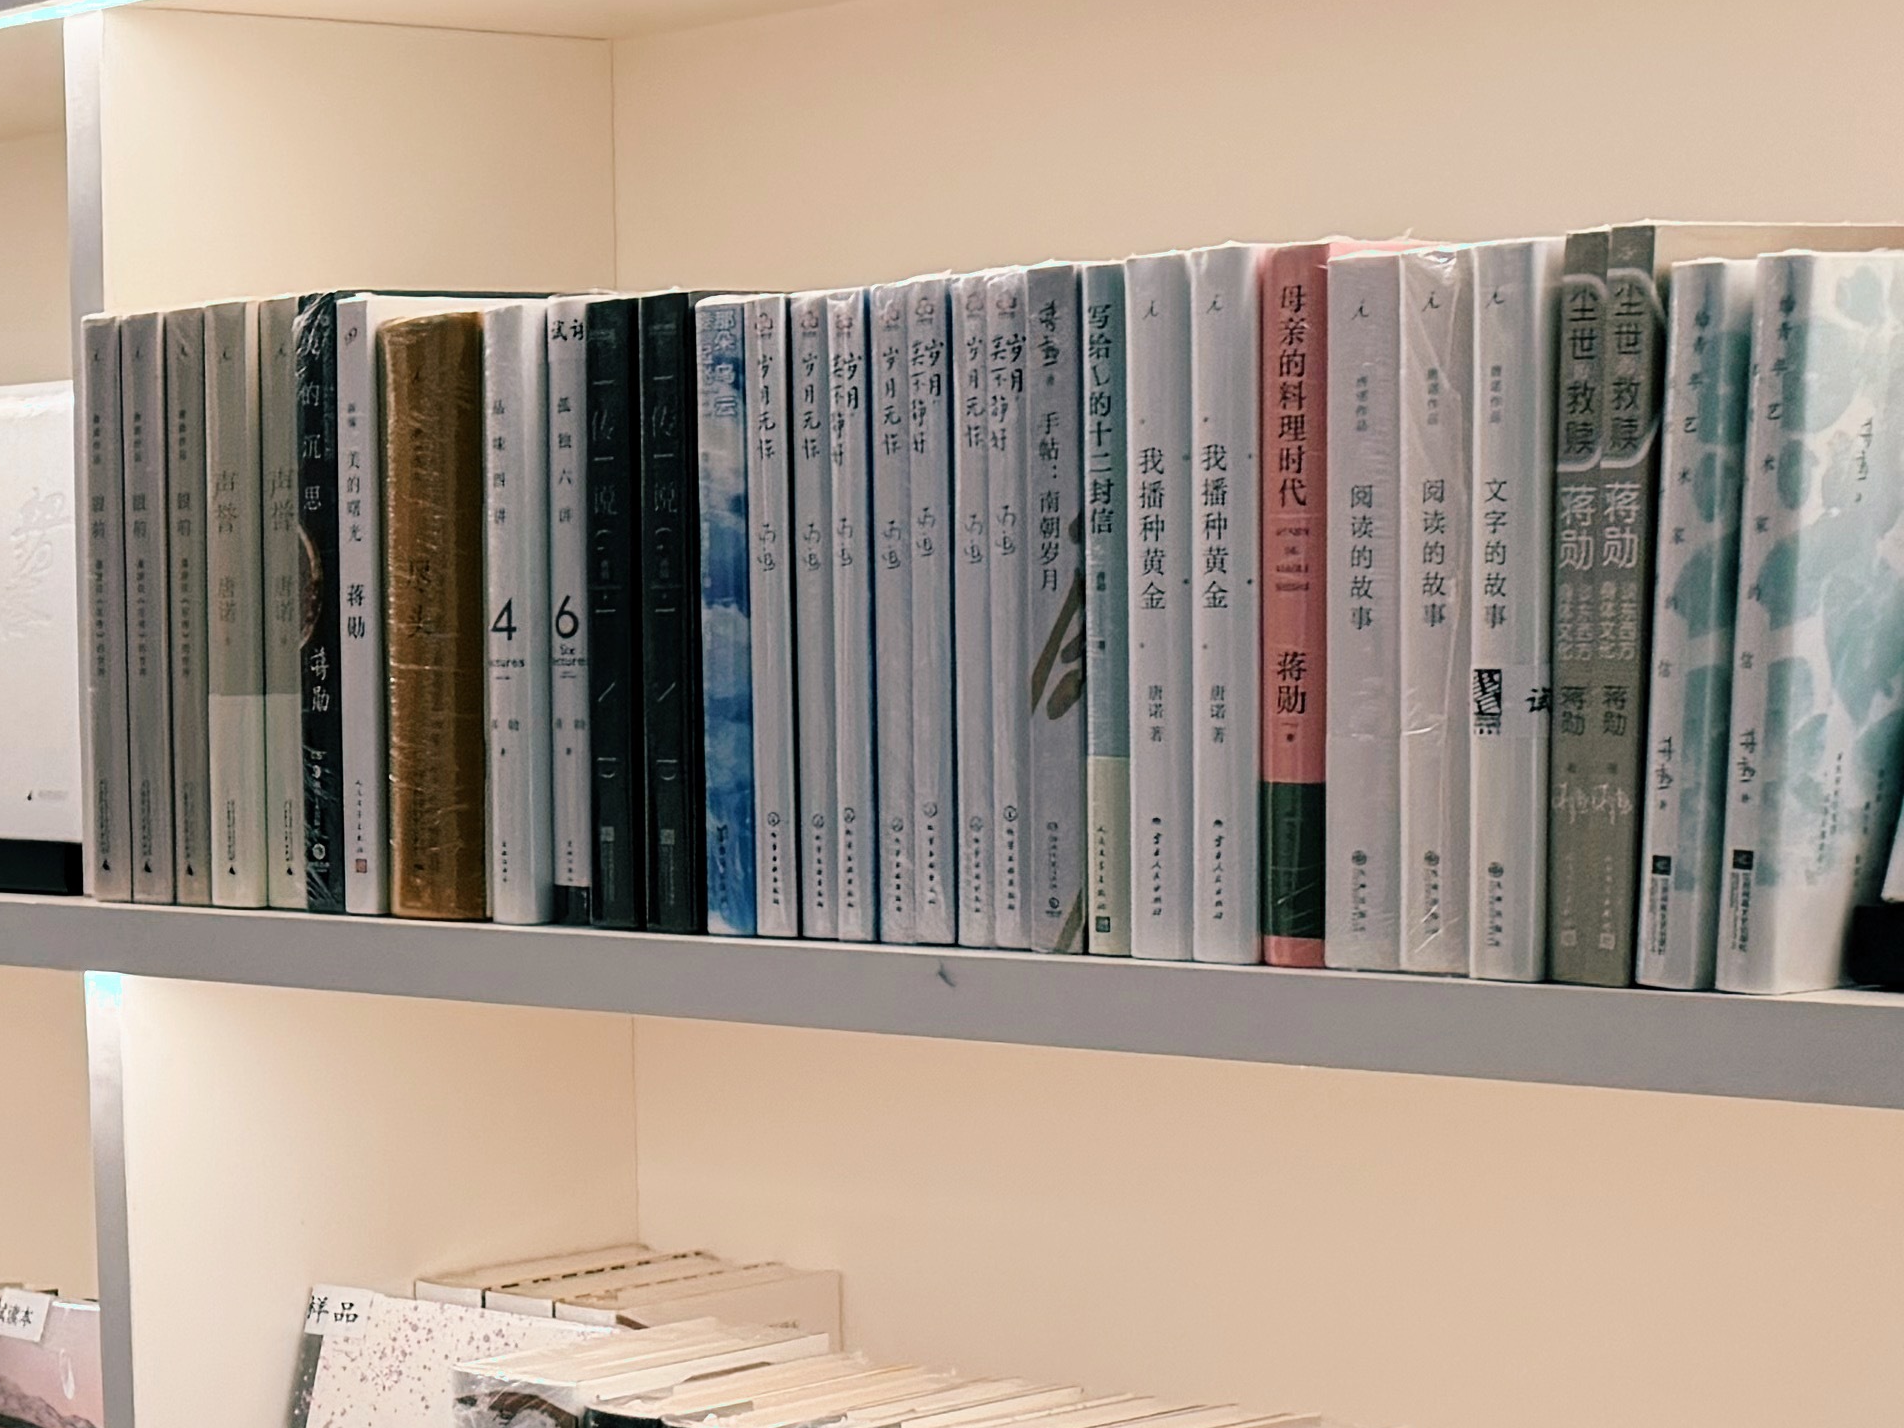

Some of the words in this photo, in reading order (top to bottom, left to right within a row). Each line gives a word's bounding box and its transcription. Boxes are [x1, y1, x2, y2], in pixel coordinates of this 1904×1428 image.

[711, 306, 739, 421] 那朵乌云
[1277, 283, 1309, 509] 母亲的料理时代
[1566, 282, 1598, 456] 尘世救赎
[1609, 278, 1645, 453] 尘世救赎
[346, 449, 364, 543] 美的曙光
[557, 395, 572, 526] 孤独六讲
[213, 470, 240, 537] 声誉
[268, 468, 296, 535] 声誉
[1038, 410, 1062, 593] 手帖：南朝岁月
[1137, 445, 1166, 611] 我播种黄金
[1200, 442, 1229, 610] 我播种黄金
[1558, 484, 1598, 572] 蒋勋
[1601, 481, 1642, 571] 蒋勋
[1349, 483, 1374, 631] 阅读的故事
[1421, 477, 1447, 629] 阅读的故事
[1483, 477, 1508, 630] 文字的故事
[346, 583, 367, 640] 蒋勋
[491, 598, 517, 642] 4
[554, 595, 580, 640] 6
[310, 646, 331, 714] 蒋勋
[1147, 683, 1165, 721] 唐诺
[1210, 683, 1227, 720] 唐诺
[1275, 649, 1308, 717] 蒋勋
[1560, 684, 1588, 738] 蒋勋
[1602, 684, 1629, 737] 蒋勋
[1148, 724, 1164, 744] 著
[1211, 724, 1226, 744] 著
[307, 1294, 360, 1326] 样品
